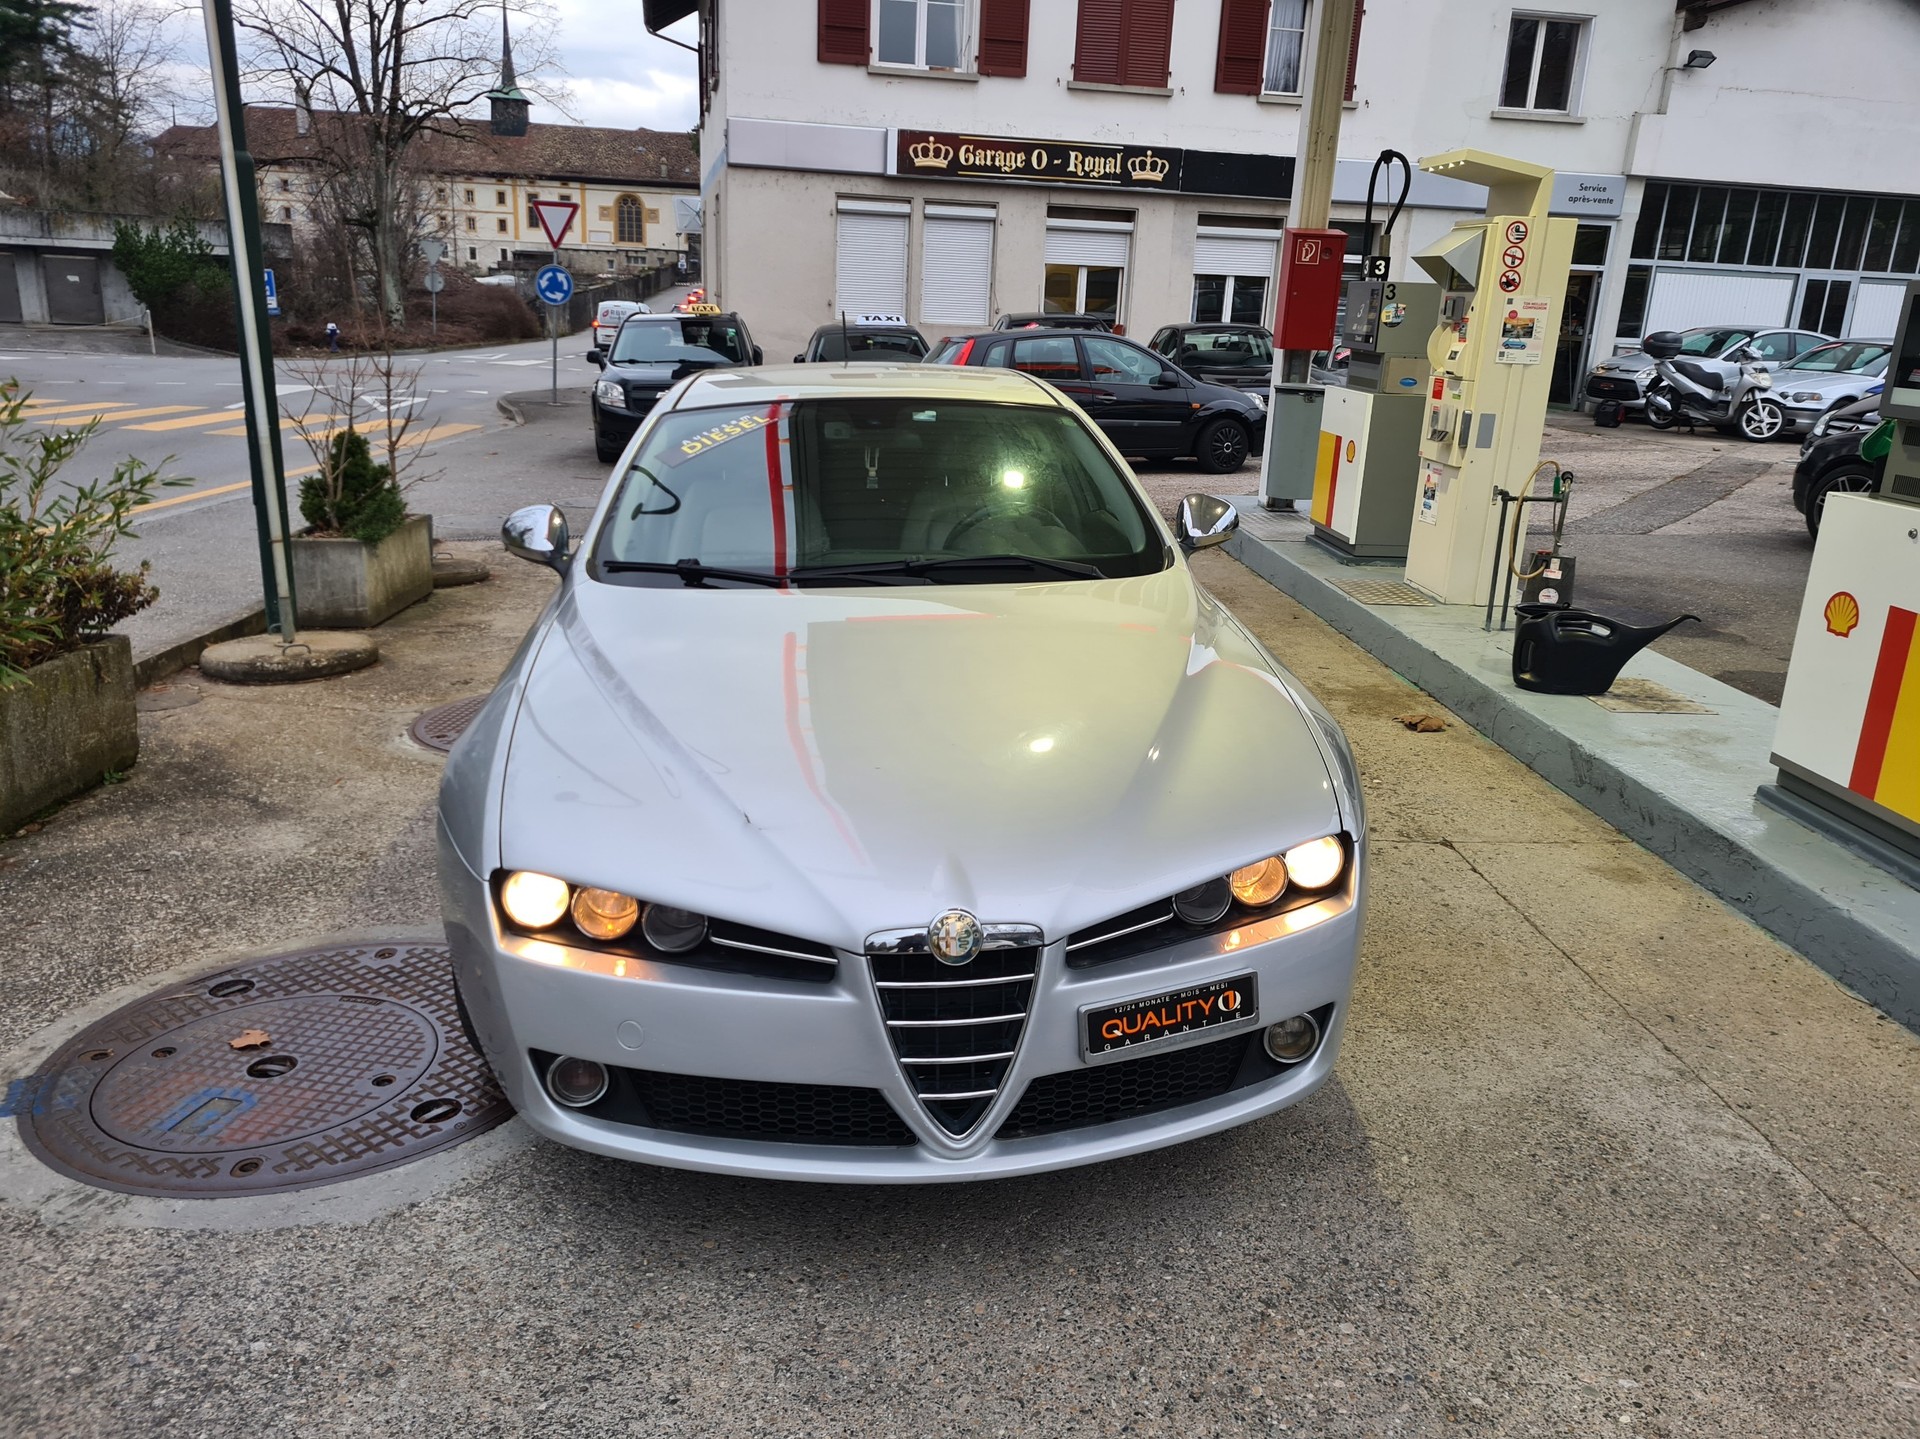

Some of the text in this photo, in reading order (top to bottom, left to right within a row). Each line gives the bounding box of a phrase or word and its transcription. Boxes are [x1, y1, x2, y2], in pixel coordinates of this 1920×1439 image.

[958, 144, 1026, 173] Garage
[1031, 148, 1048, 170] O
[1067, 151, 1124, 178] Royal
[1578, 182, 1607, 192] Service
[1568, 195, 1614, 204] après-vente
[1363, 260, 1369, 275] 3
[1374, 260, 1386, 275] 3
[1385, 283, 1396, 300] 3
[691, 305, 717, 313] TAXI
[681, 415, 770, 454] DIESEL
[1114, 1003, 1136, 1014] 12/24
[1139, 995, 1170, 1009] MONATE
[1180, 988, 1200, 999] MOIS
[1209, 982, 1228, 992] MESI
[1102, 996, 1215, 1039] QUALITY
[1104, 1011, 1241, 1051] GARANTIE
